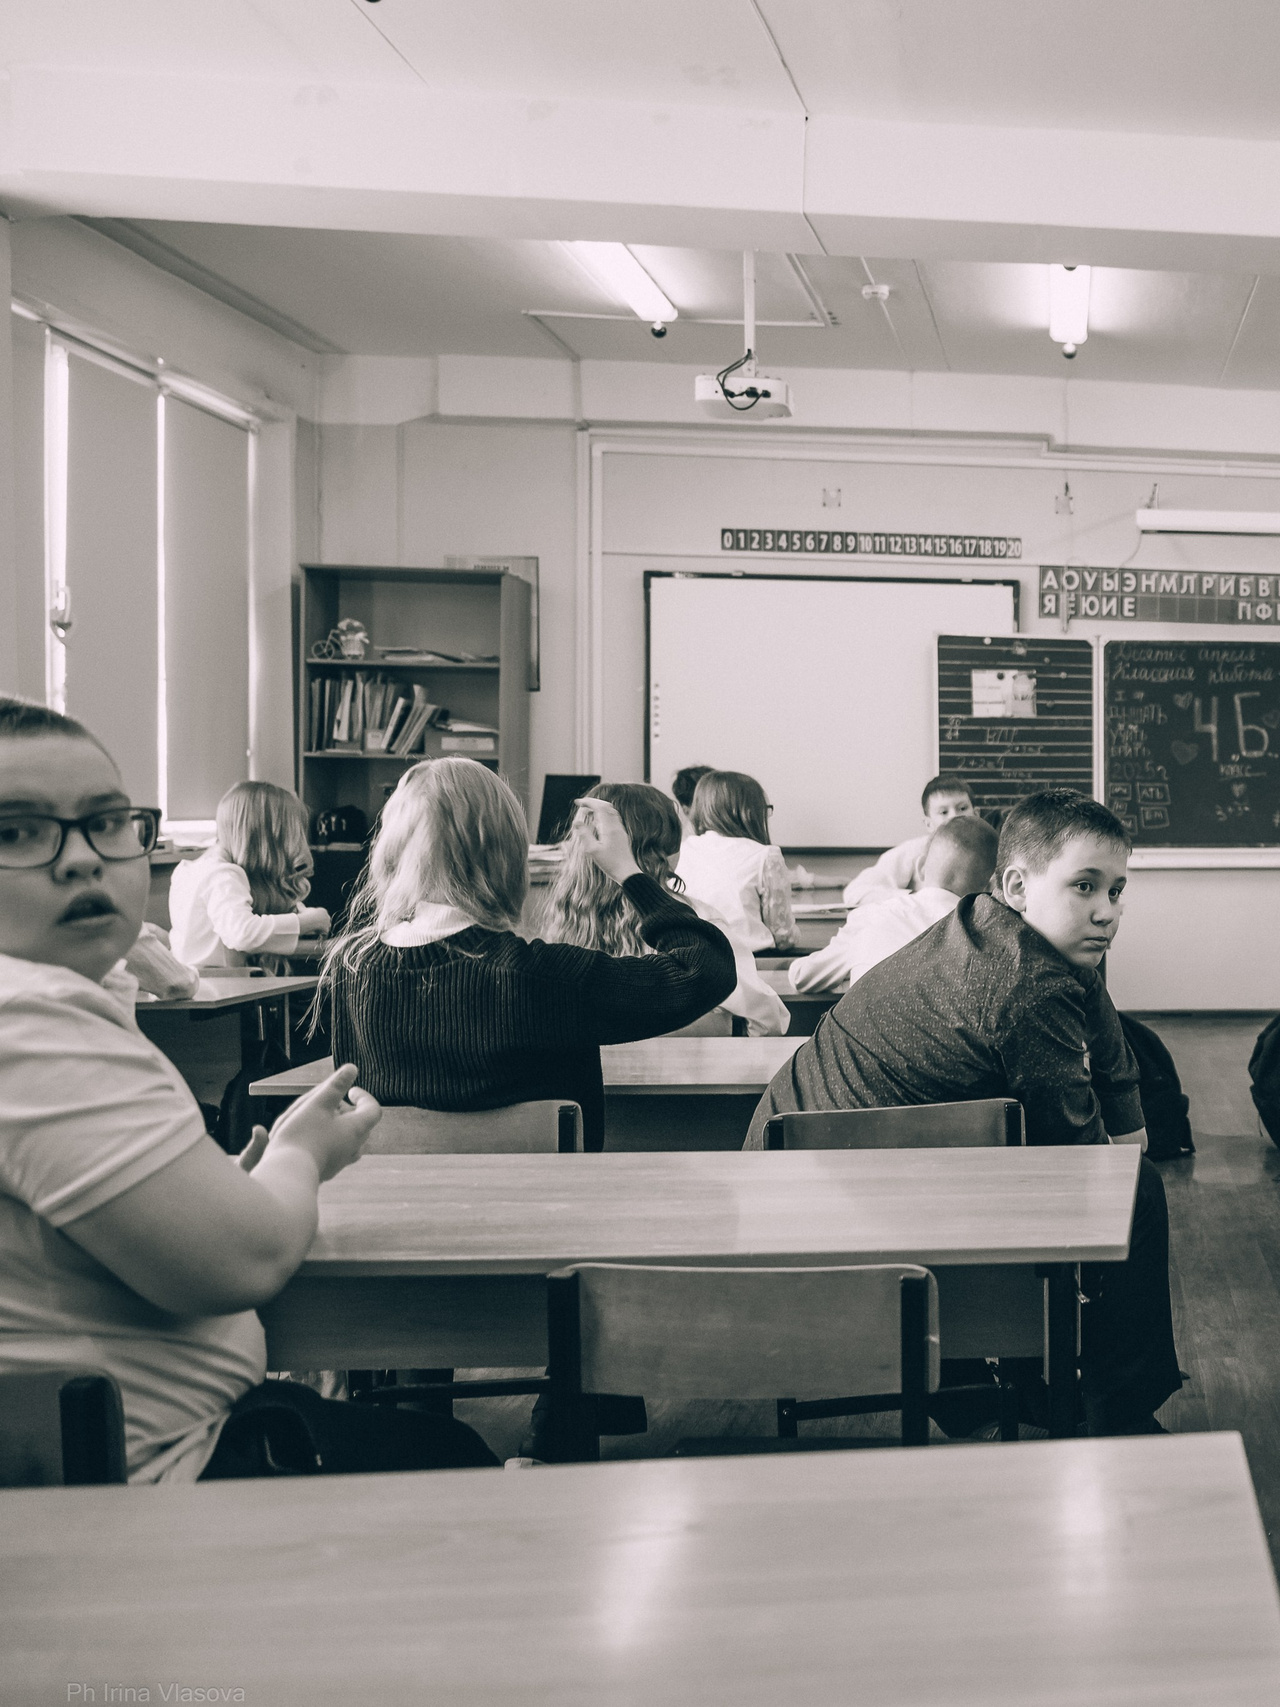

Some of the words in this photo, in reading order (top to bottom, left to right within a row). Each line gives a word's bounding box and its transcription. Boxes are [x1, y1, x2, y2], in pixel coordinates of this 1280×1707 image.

[724, 531, 732, 548] 0
[738, 532, 745, 549] 1
[751, 532, 760, 549] 2
[765, 532, 773, 549] 3
[779, 533, 788, 550] 4
[792, 533, 801, 550] 5
[805, 534, 815, 551] 6
[819, 534, 828, 551] 7
[833, 534, 842, 551] 8
[846, 535, 856, 552] 9
[860, 535, 872, 552] 10
[874, 536, 886, 552] 11
[889, 536, 902, 553] 12
[904, 537, 917, 553] 13
[919, 537, 932, 554] 14
[934, 538, 947, 554] 15
[949, 538, 962, 555] 16
[964, 539, 977, 555] 17
[979, 539, 992, 555] 18
[994, 540, 1006, 556] 19
[1008, 540, 1020, 556] 20
